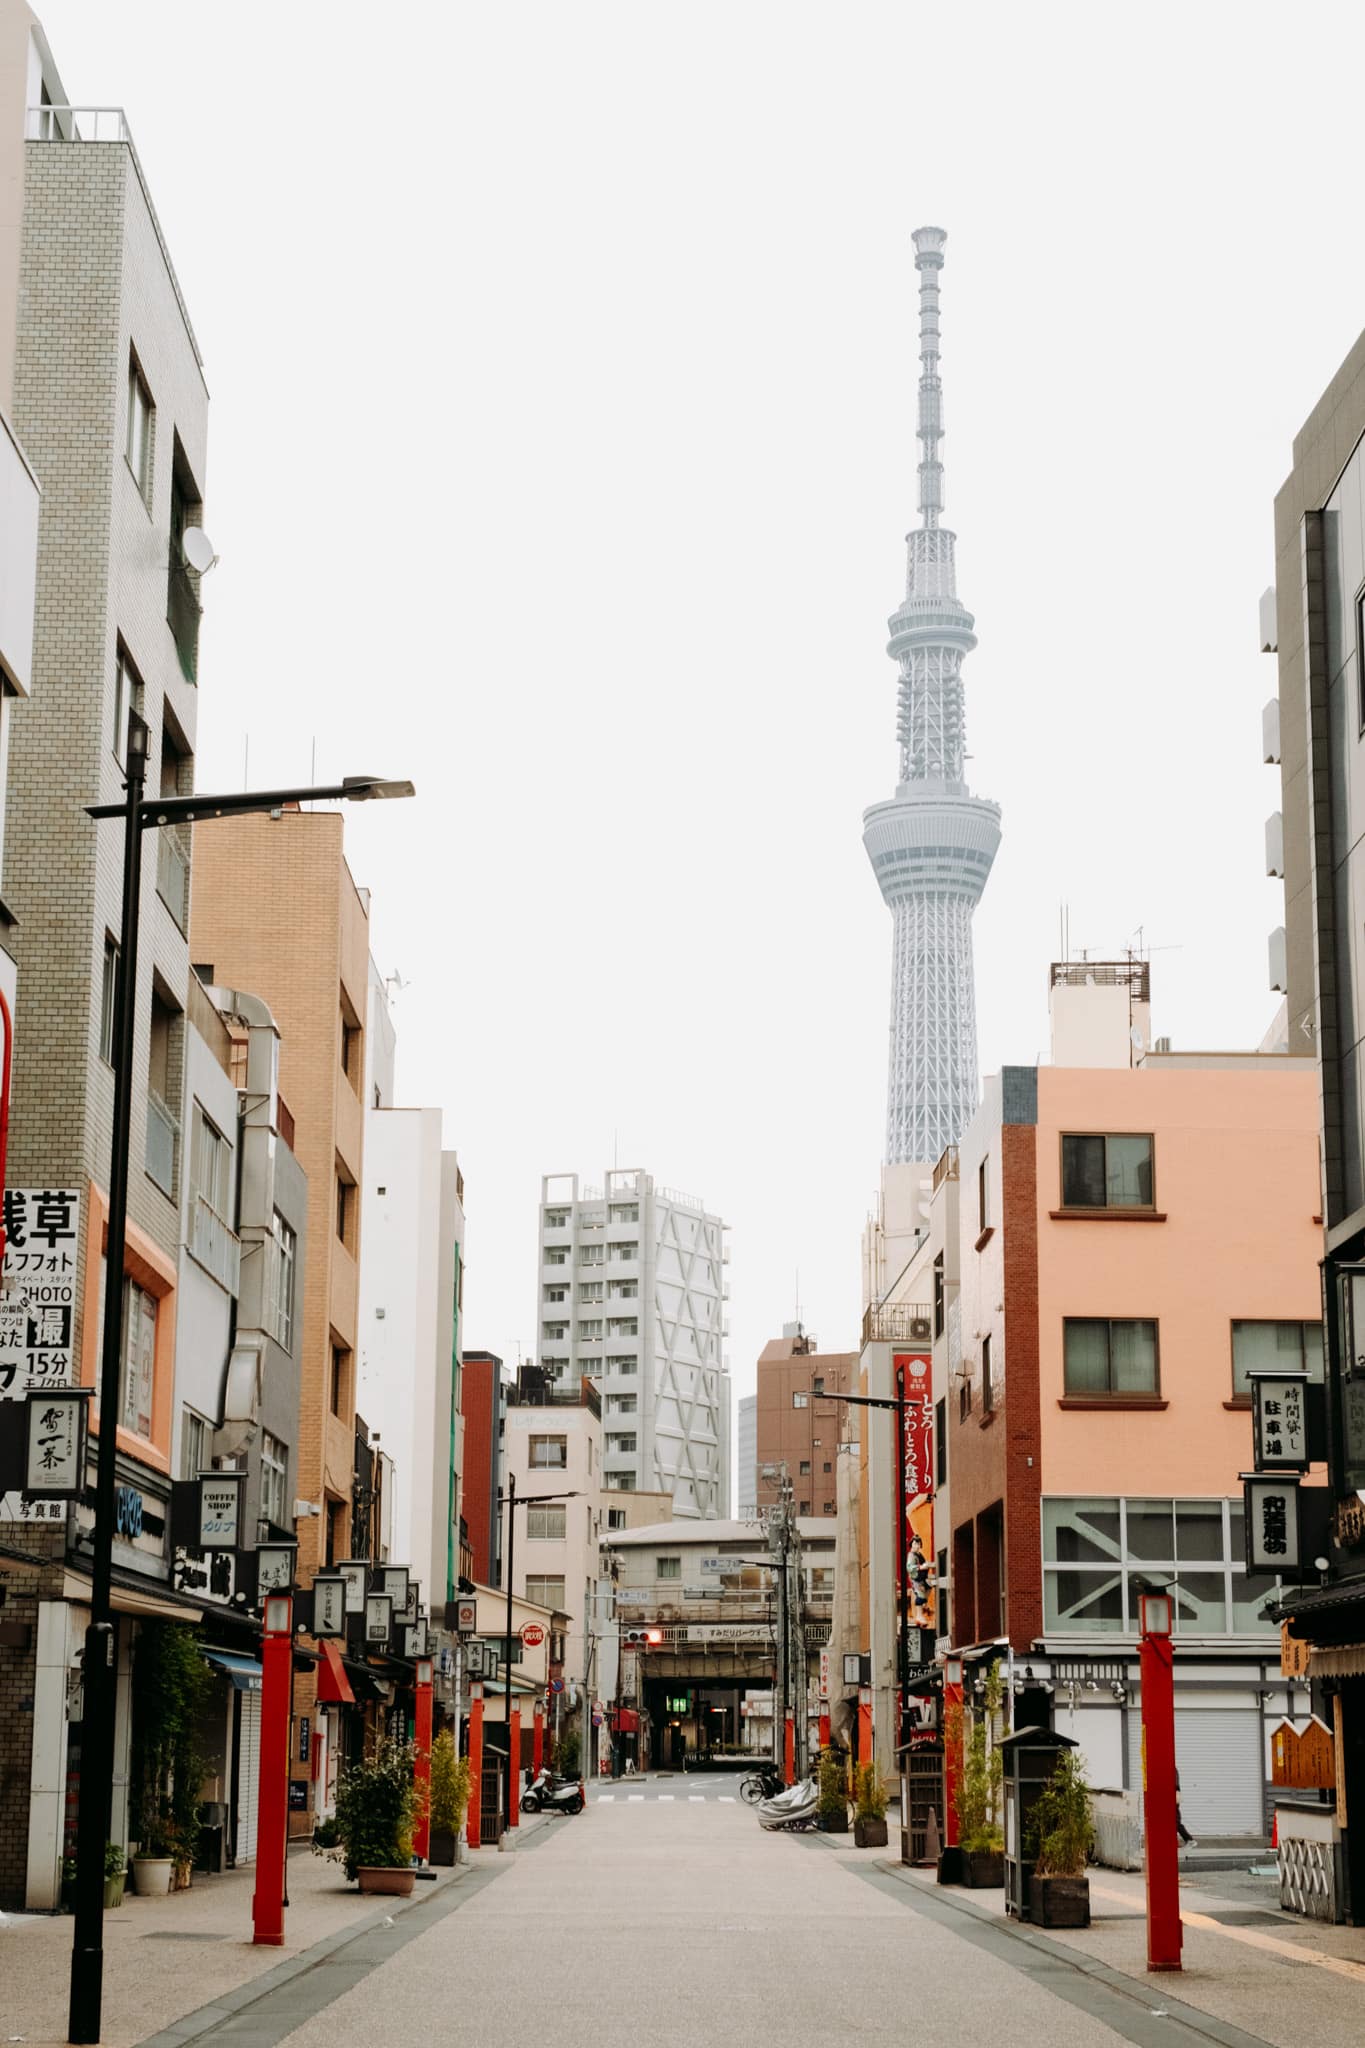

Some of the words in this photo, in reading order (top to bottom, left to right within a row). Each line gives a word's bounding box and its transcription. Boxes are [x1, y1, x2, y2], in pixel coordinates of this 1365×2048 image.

[26, 1353, 68, 1375] 15分
[1285, 1387, 1301, 1450] 時間貸し
[1265, 1400, 1282, 1456] 駐車場
[204, 1493, 236, 1501] COFFEE
[208, 1502, 231, 1510] SHOP
[20, 1503, 61, 1518] 写真館
